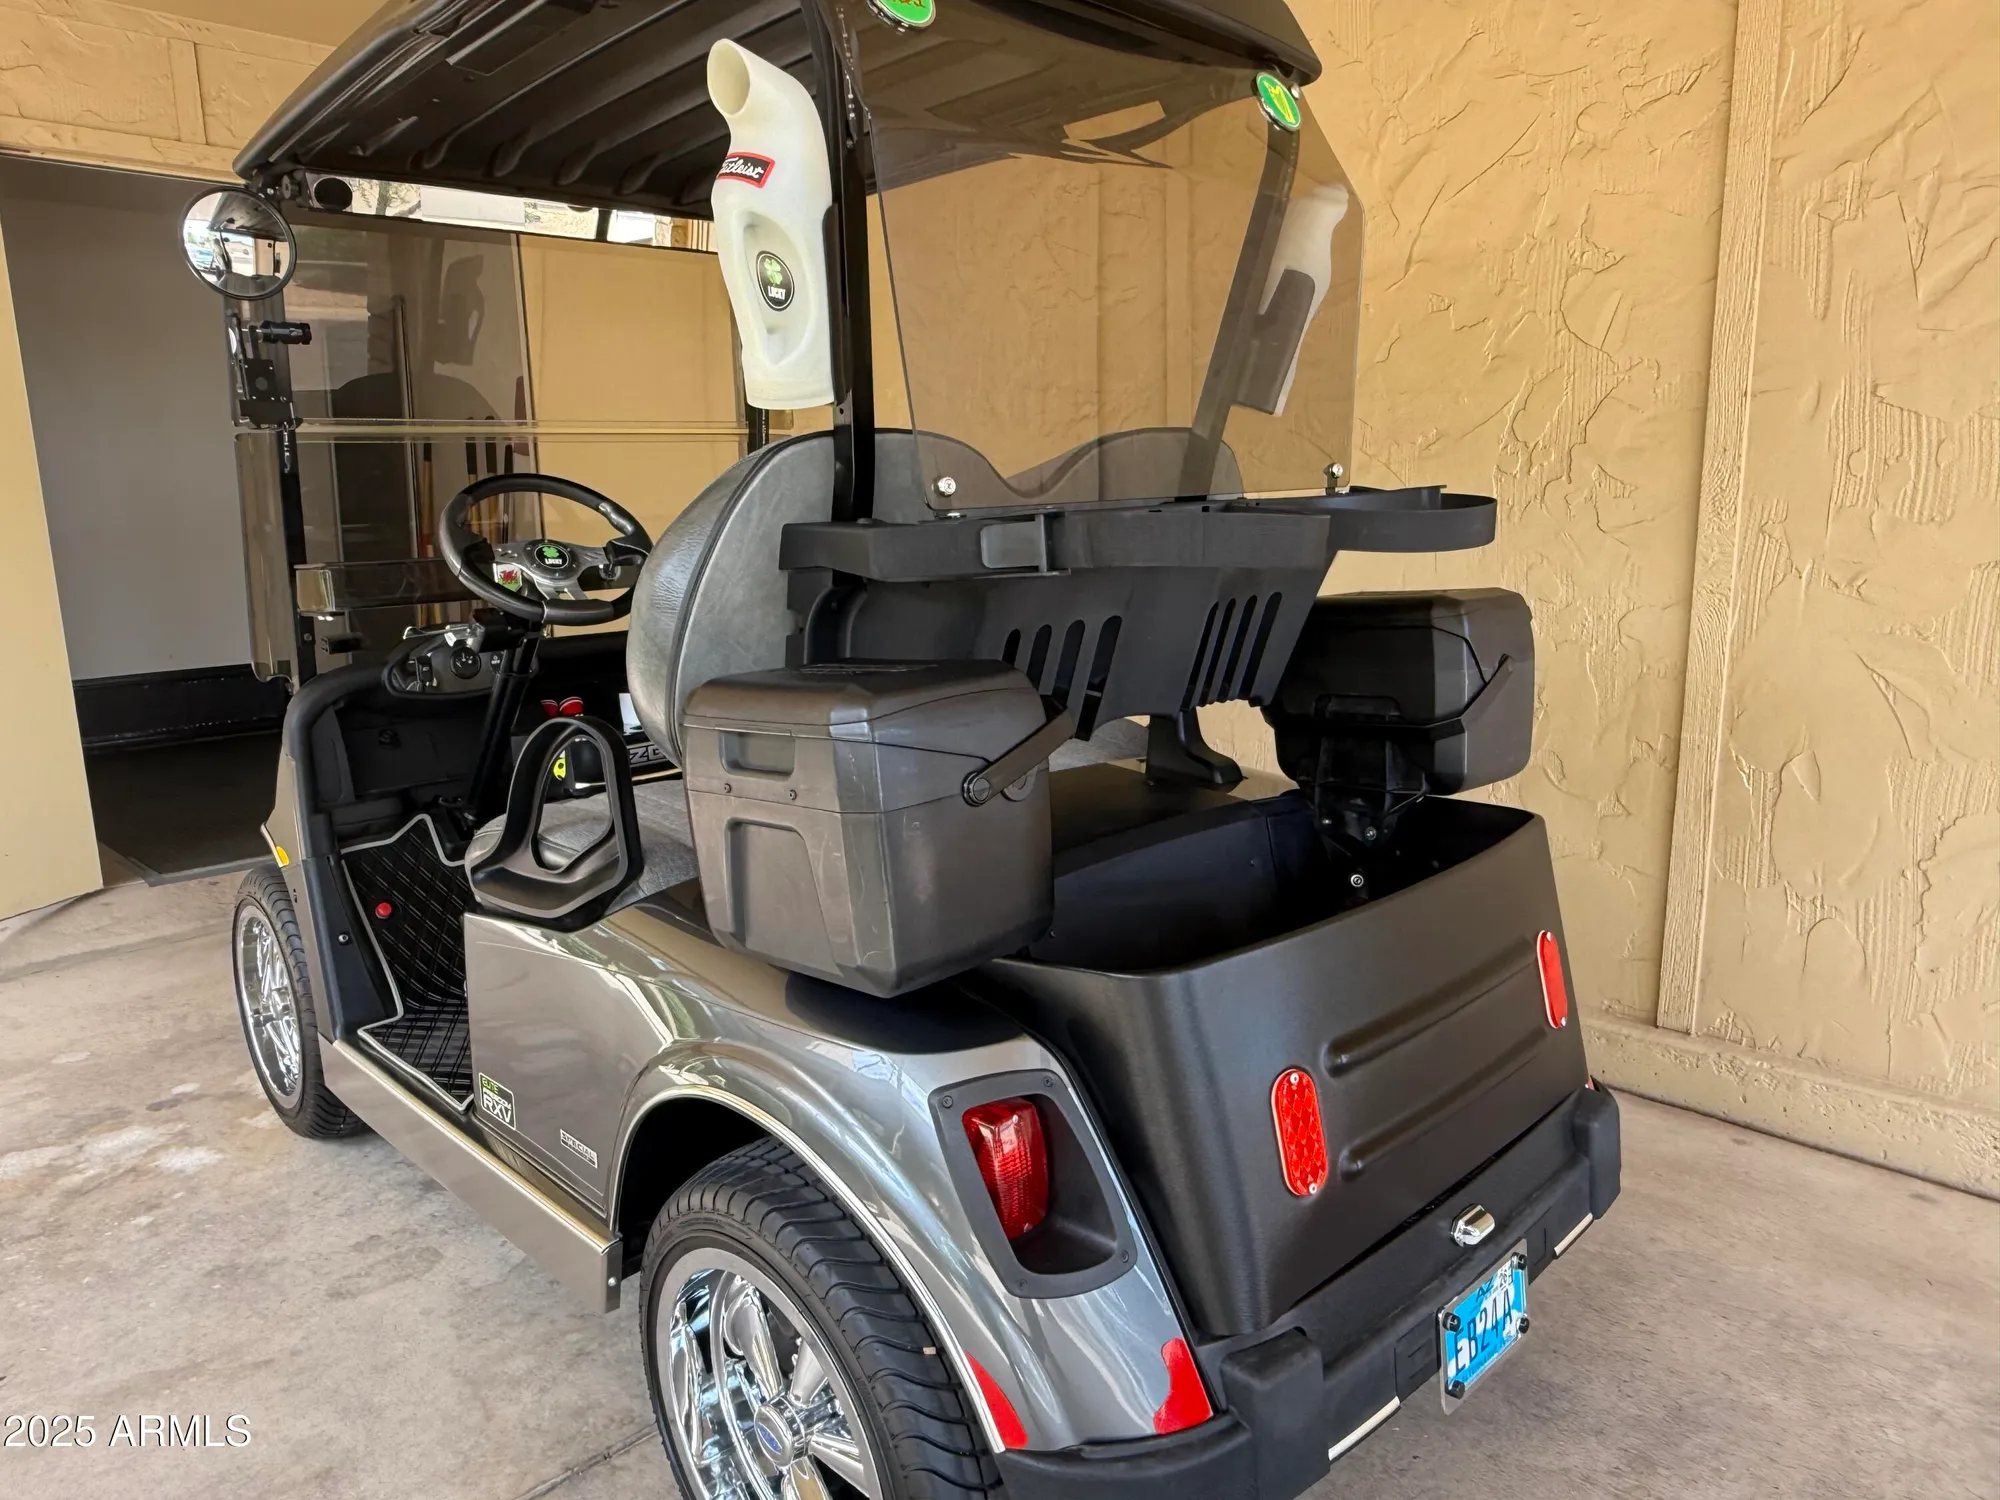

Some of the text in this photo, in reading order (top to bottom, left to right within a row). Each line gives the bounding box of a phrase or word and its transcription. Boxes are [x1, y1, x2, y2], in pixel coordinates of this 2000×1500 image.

[767, 285, 786, 300] LUCKY
[483, 1094, 512, 1123] RXV
[1455, 1289, 1513, 1376] EB24A
